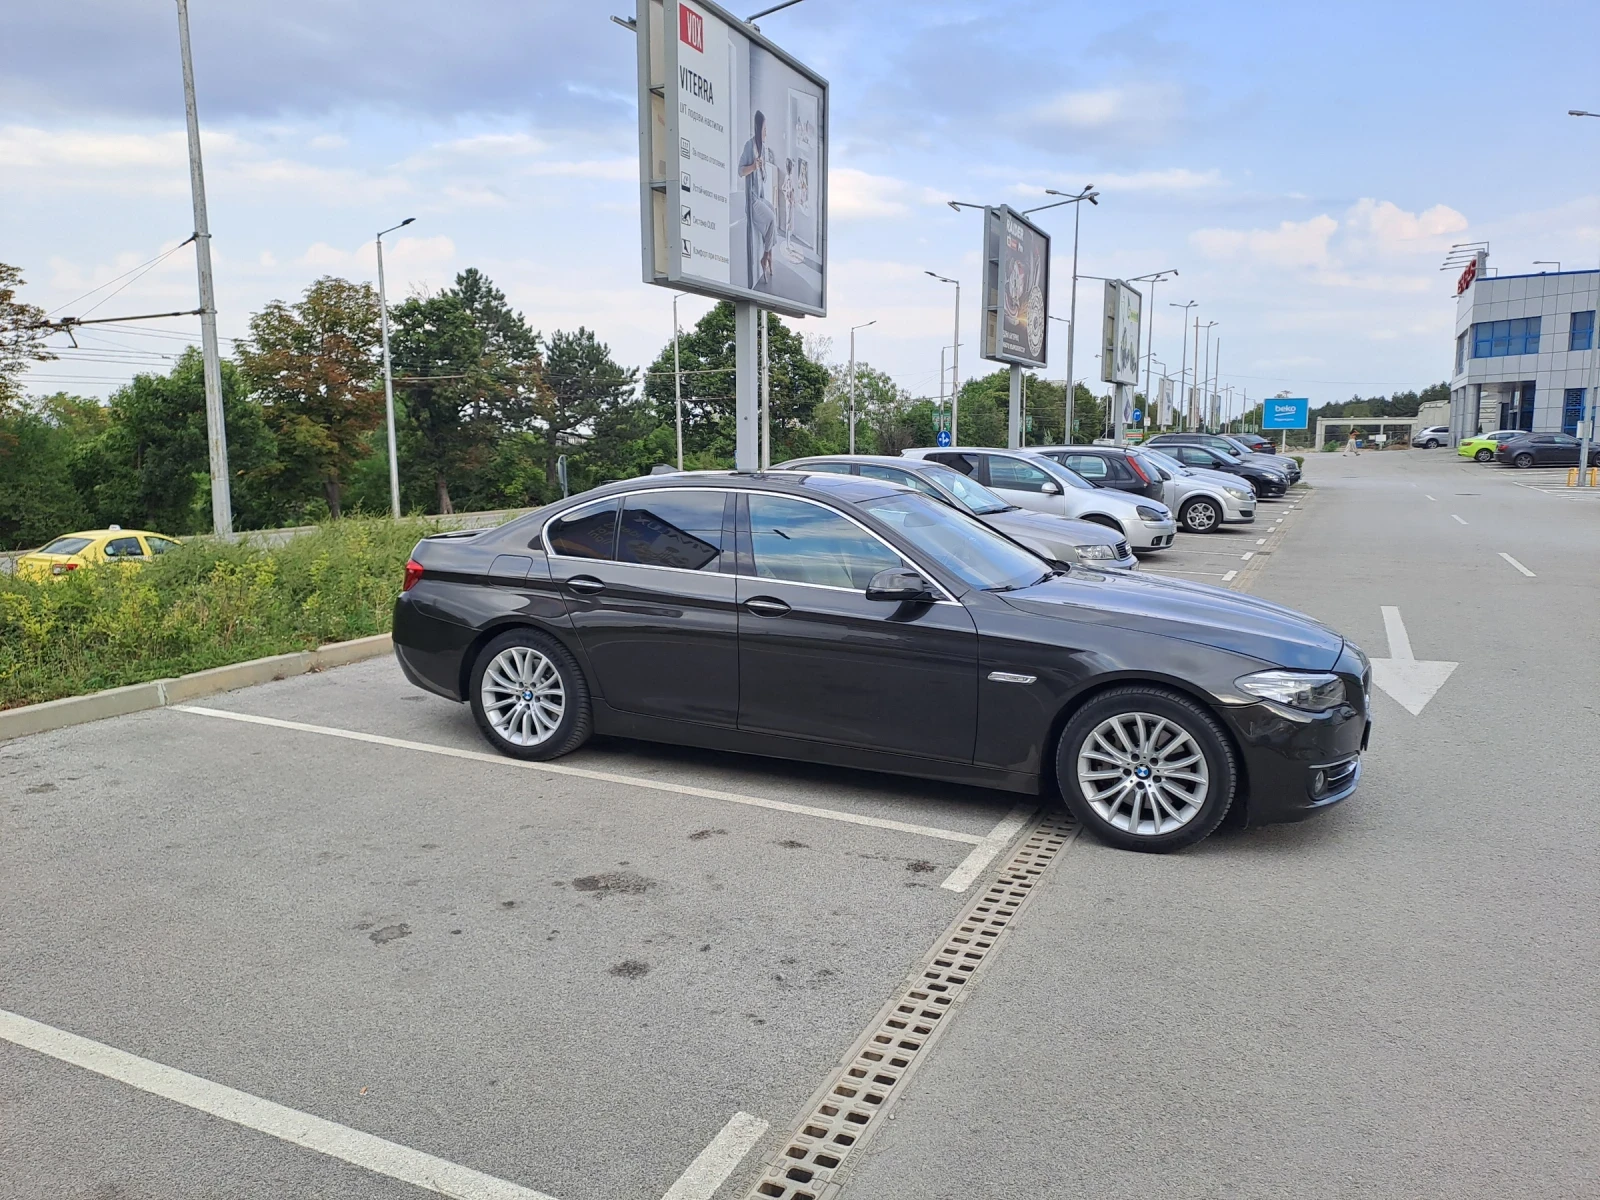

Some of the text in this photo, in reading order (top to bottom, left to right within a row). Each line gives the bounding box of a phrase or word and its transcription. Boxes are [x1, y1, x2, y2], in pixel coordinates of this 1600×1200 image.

[687, 10, 702, 50] VOX
[680, 64, 714, 105] VITERRA
[1275, 404, 1296, 413] beko
